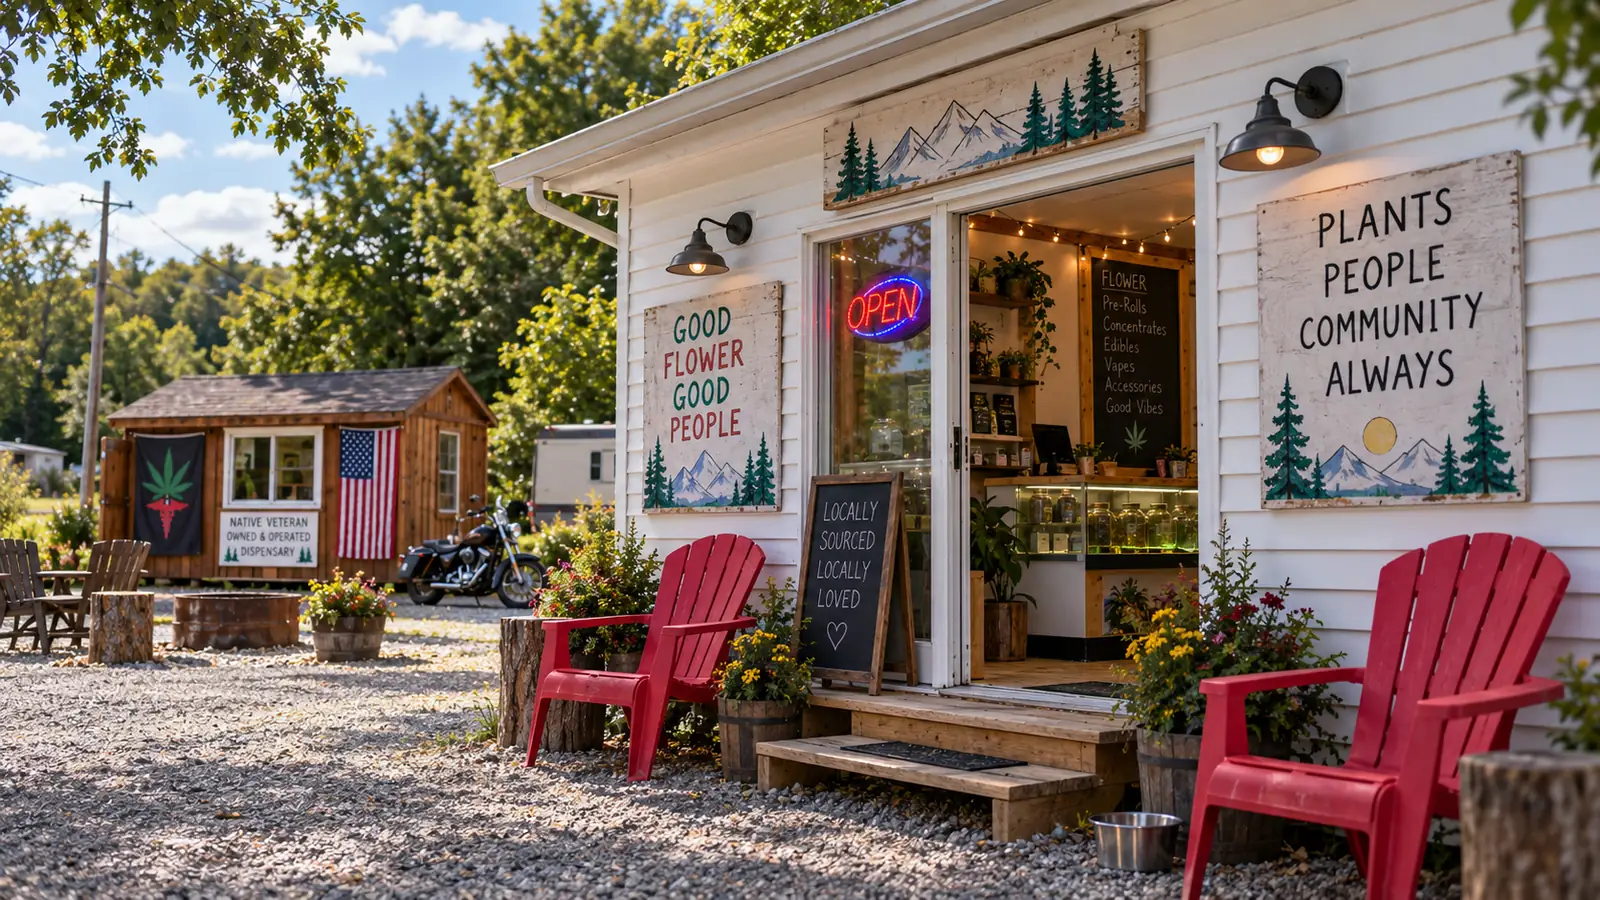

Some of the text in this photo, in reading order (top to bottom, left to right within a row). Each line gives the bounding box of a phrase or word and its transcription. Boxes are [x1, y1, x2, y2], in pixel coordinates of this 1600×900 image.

[1318, 187, 1452, 248] PLANTS
[1101, 269, 1147, 291] FLOWER
[1324, 243, 1445, 298] PEOPLE
[847, 284, 918, 329] OPEN
[1103, 295, 1148, 315] Pre-Rolls
[673, 306, 731, 345] GOOD
[1103, 316, 1167, 336] Concentrates
[1300, 291, 1484, 350] COMMUNITY
[1104, 336, 1140, 354] Edibles
[664, 338, 744, 380] FLOWER
[1104, 356, 1135, 378] Vapes
[1325, 348, 1455, 397] ALWAYS
[673, 376, 730, 411] GOOD
[1104, 377, 1162, 394] Accessories
[1106, 397, 1164, 415] Good Vibes
[670, 408, 741, 444] PEOPLE
[230, 517, 308, 528] NATIVE VETERAN
[823, 501, 879, 522] LOCALLY
[226, 531, 311, 542] OWNED & OPERATED
[819, 530, 876, 551] SOURCED
[240, 546, 295, 557] DISPENSARY
[816, 560, 871, 582] LOCALLY
[817, 588, 861, 609] LOVED
